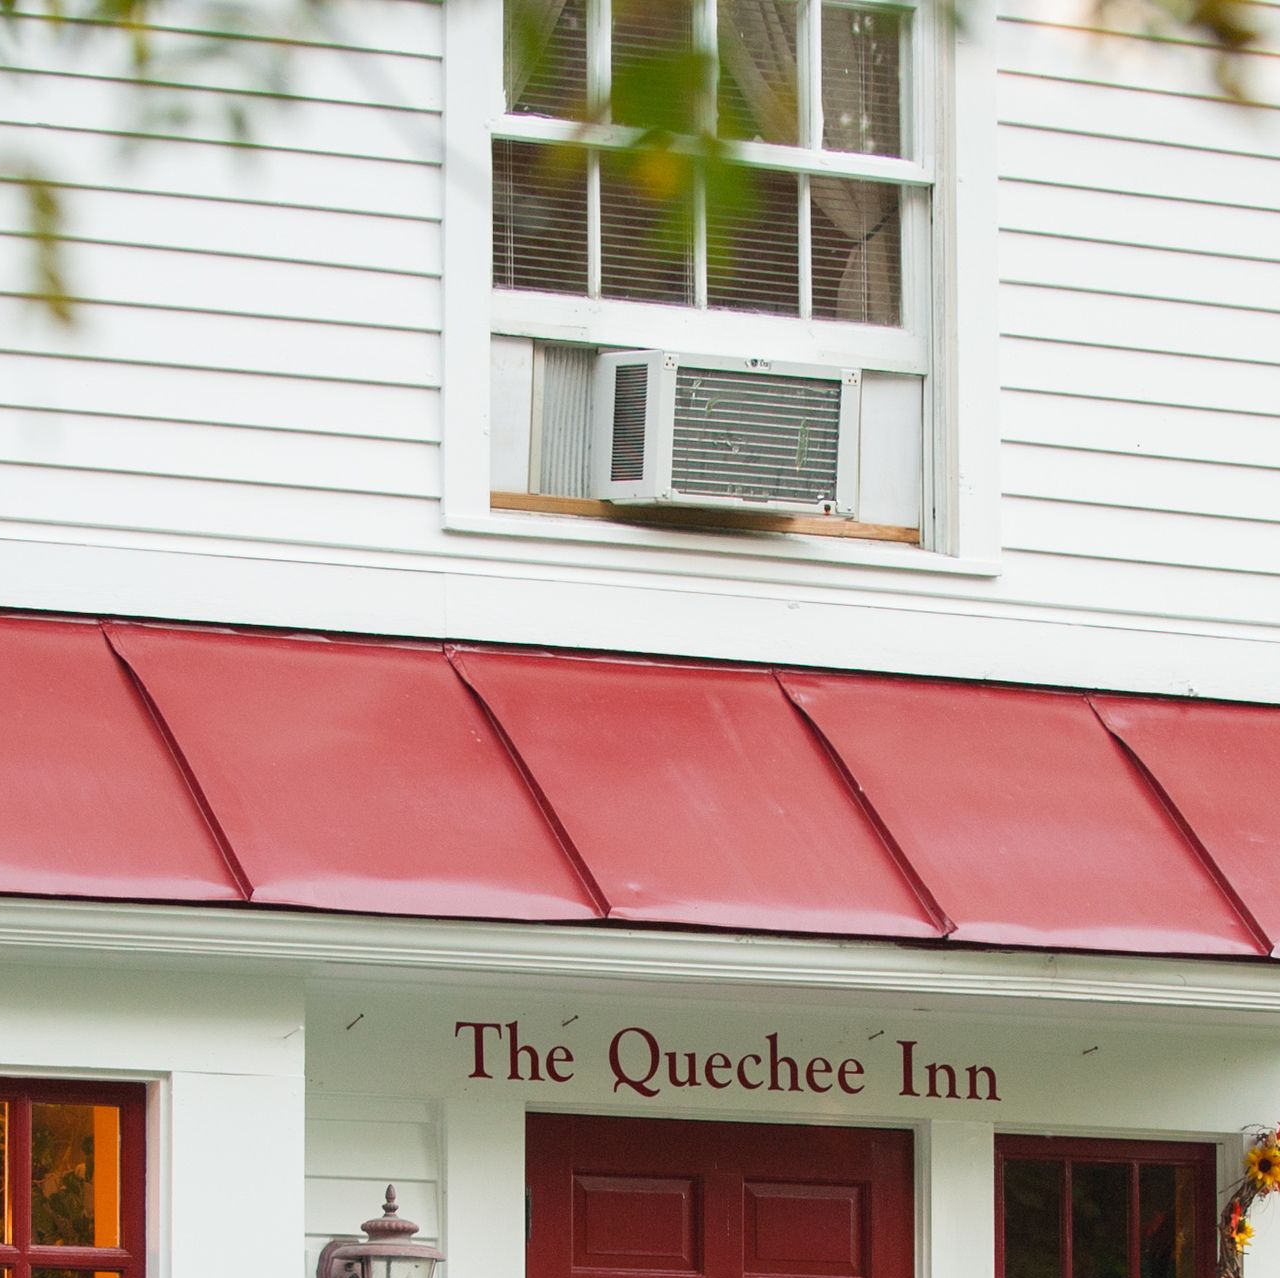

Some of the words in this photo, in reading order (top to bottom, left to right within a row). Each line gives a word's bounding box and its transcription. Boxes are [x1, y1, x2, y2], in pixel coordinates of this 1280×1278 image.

[454, 1021, 575, 1082] The
[608, 1026, 865, 1097] Quechee
[896, 1040, 1001, 1101] Inn
